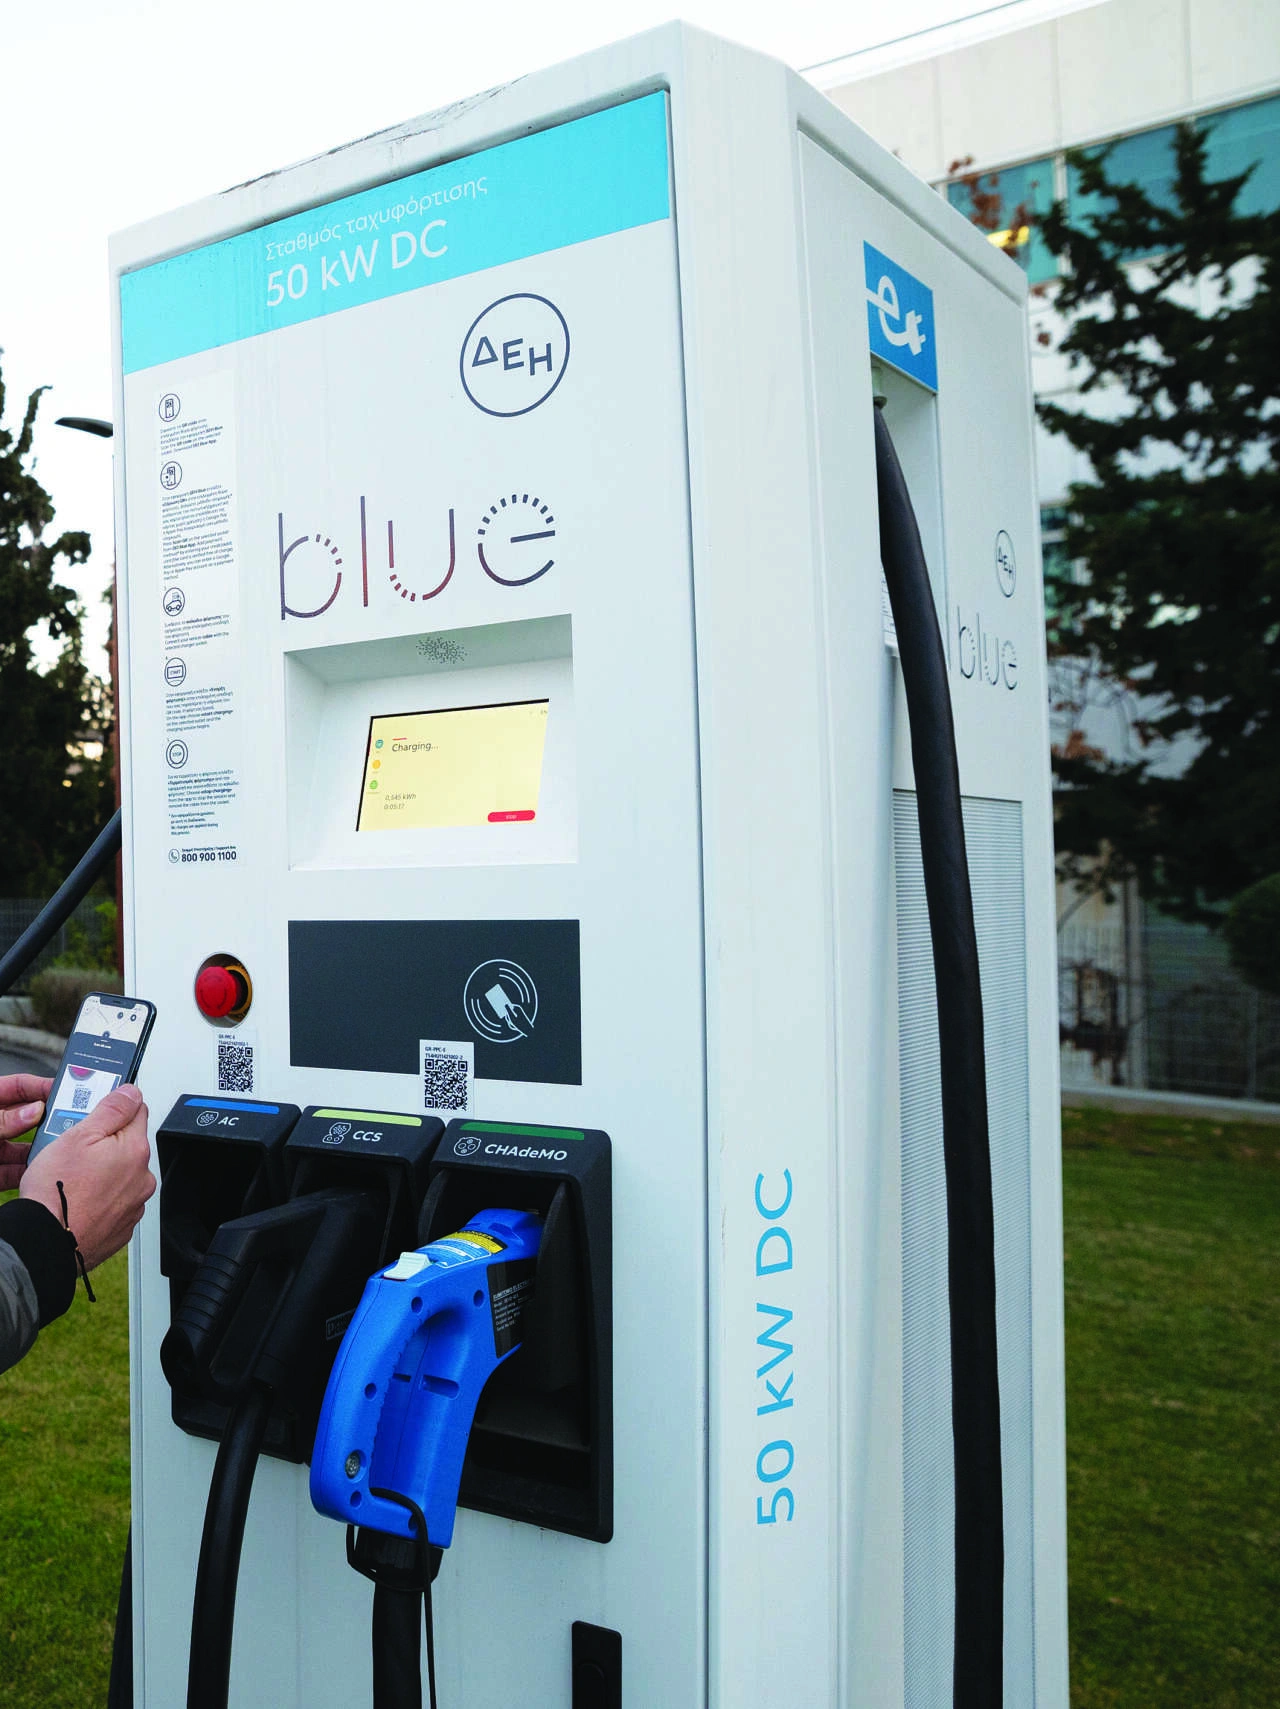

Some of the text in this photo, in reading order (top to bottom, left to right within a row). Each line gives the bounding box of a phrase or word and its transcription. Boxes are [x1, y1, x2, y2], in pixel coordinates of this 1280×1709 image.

[265, 174, 489, 262] Σταθμός ταχυφόρτισης
[266, 219, 449, 307] 50 kW DC
[471, 335, 553, 377] ΔΕΗ
[277, 493, 556, 621] blue
[957, 605, 1018, 691] blue
[181, 850, 237, 862] 800 900 1100
[218, 1115, 240, 1127] AC
[352, 1130, 384, 1143] CCS
[483, 1143, 568, 1162] CHAdeMO
[754, 1168, 795, 1525] 50 kW DC
